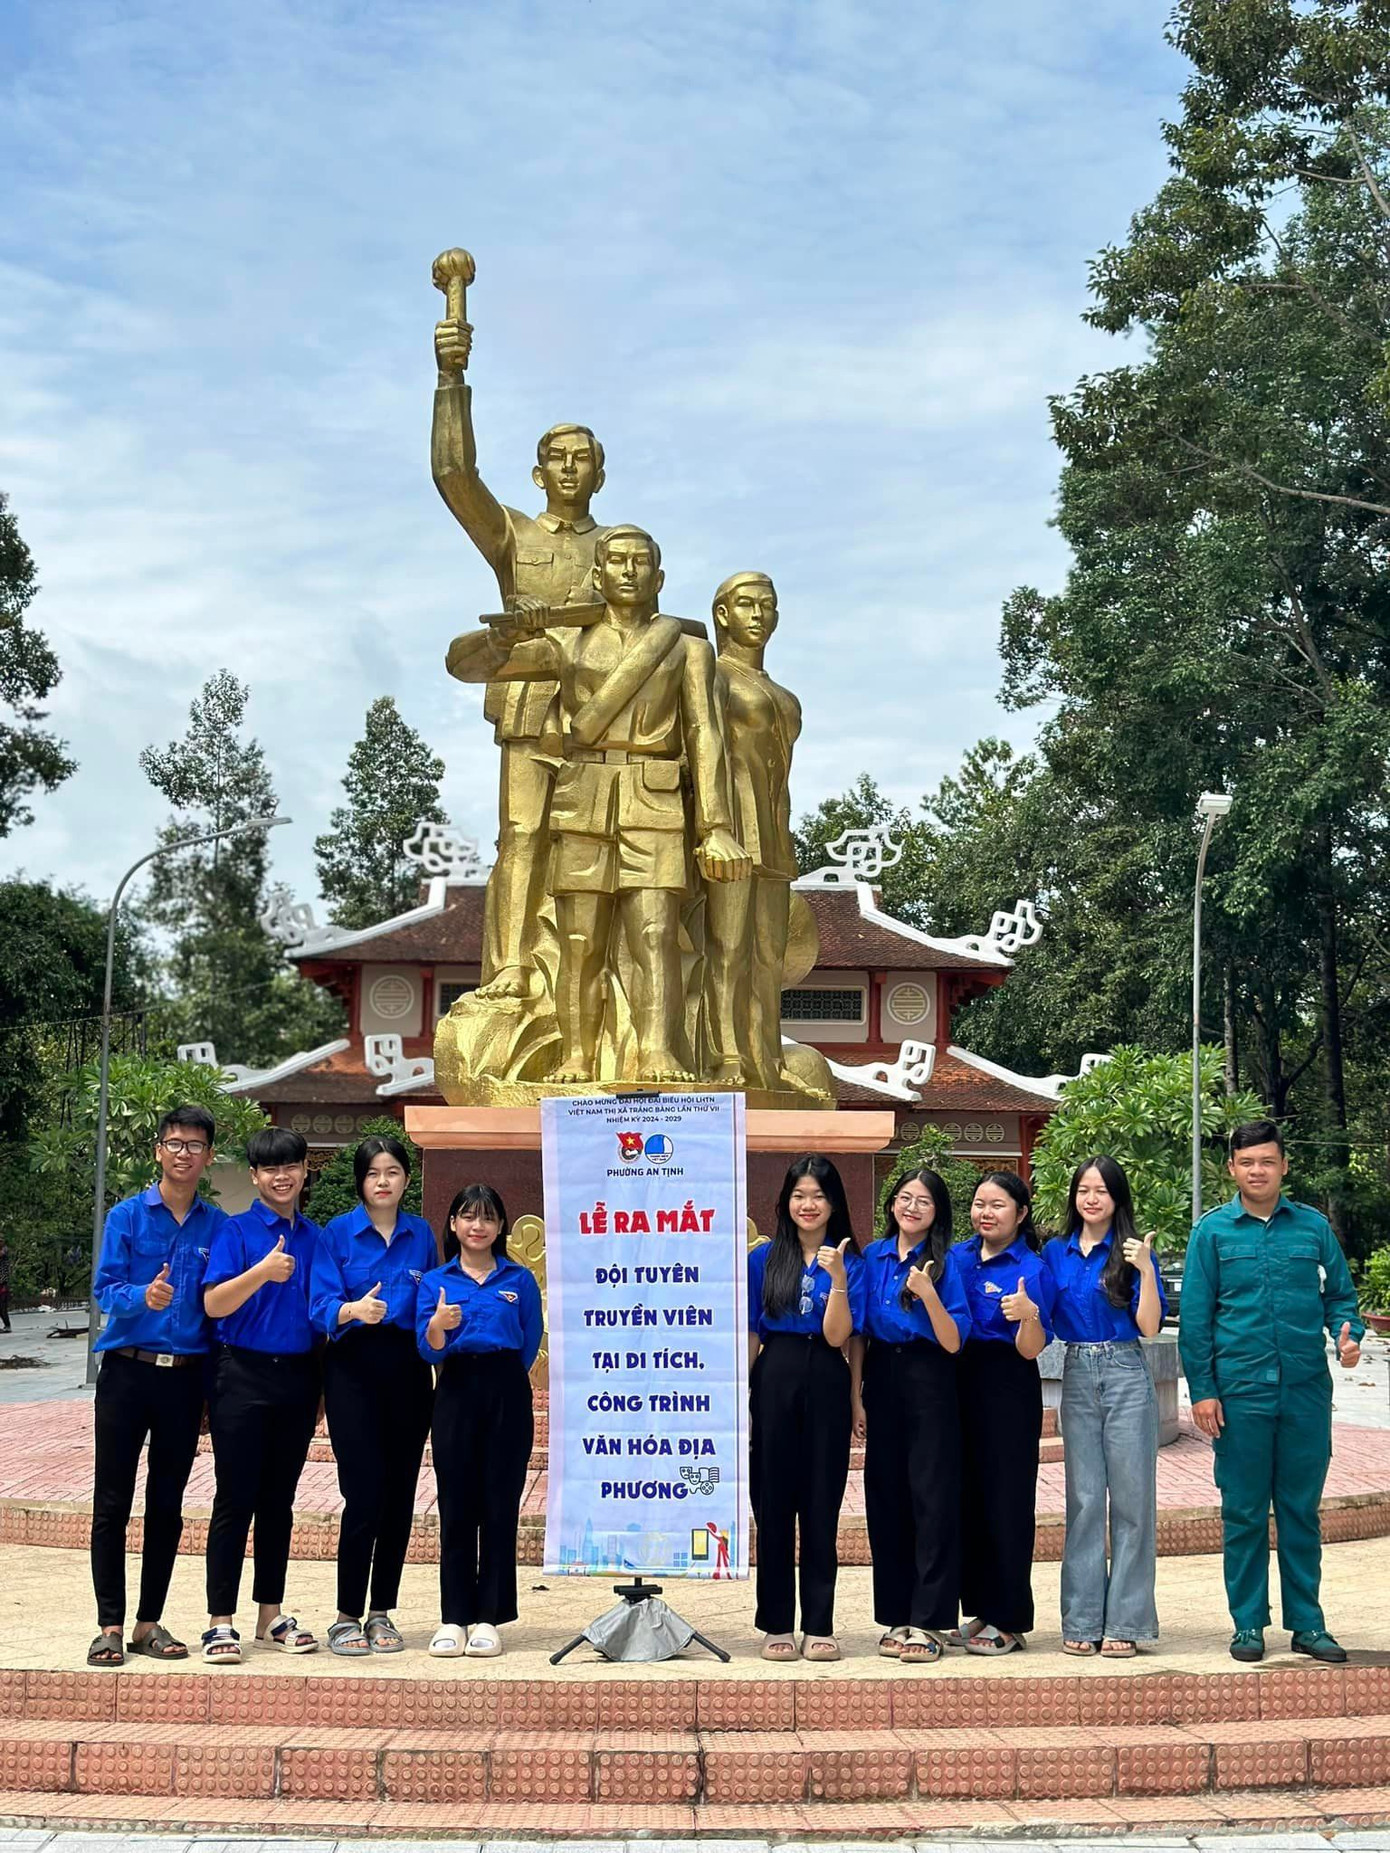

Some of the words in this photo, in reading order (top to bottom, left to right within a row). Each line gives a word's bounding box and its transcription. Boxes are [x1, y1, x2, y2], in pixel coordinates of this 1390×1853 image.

[606, 1115, 630, 1123] NHIỆM
[607, 1166, 644, 1177] PHƯỜNG
[646, 1168, 659, 1176] AN
[662, 1167, 684, 1177] TỊNH
[579, 1201, 608, 1235] LỄ
[613, 1211, 650, 1234] RA
[656, 1200, 715, 1234] MẮT
[595, 1264, 628, 1288] ĐỘI
[634, 1263, 699, 1284] TUYÊN
[584, 1303, 657, 1326] TRUYỀN
[663, 1305, 713, 1326] VIÊN
[592, 1352, 620, 1373] TẠI
[626, 1352, 646, 1369] DI
[653, 1348, 705, 1370] TÍCH,
[587, 1391, 643, 1412] CÔNG
[649, 1391, 710, 1412] TRÌNH
[582, 1434, 622, 1456] VĂN
[628, 1434, 673, 1456] HÓA
[679, 1438, 716, 1460] ĐỊA
[601, 1481, 688, 1500] PHƯƠNG
